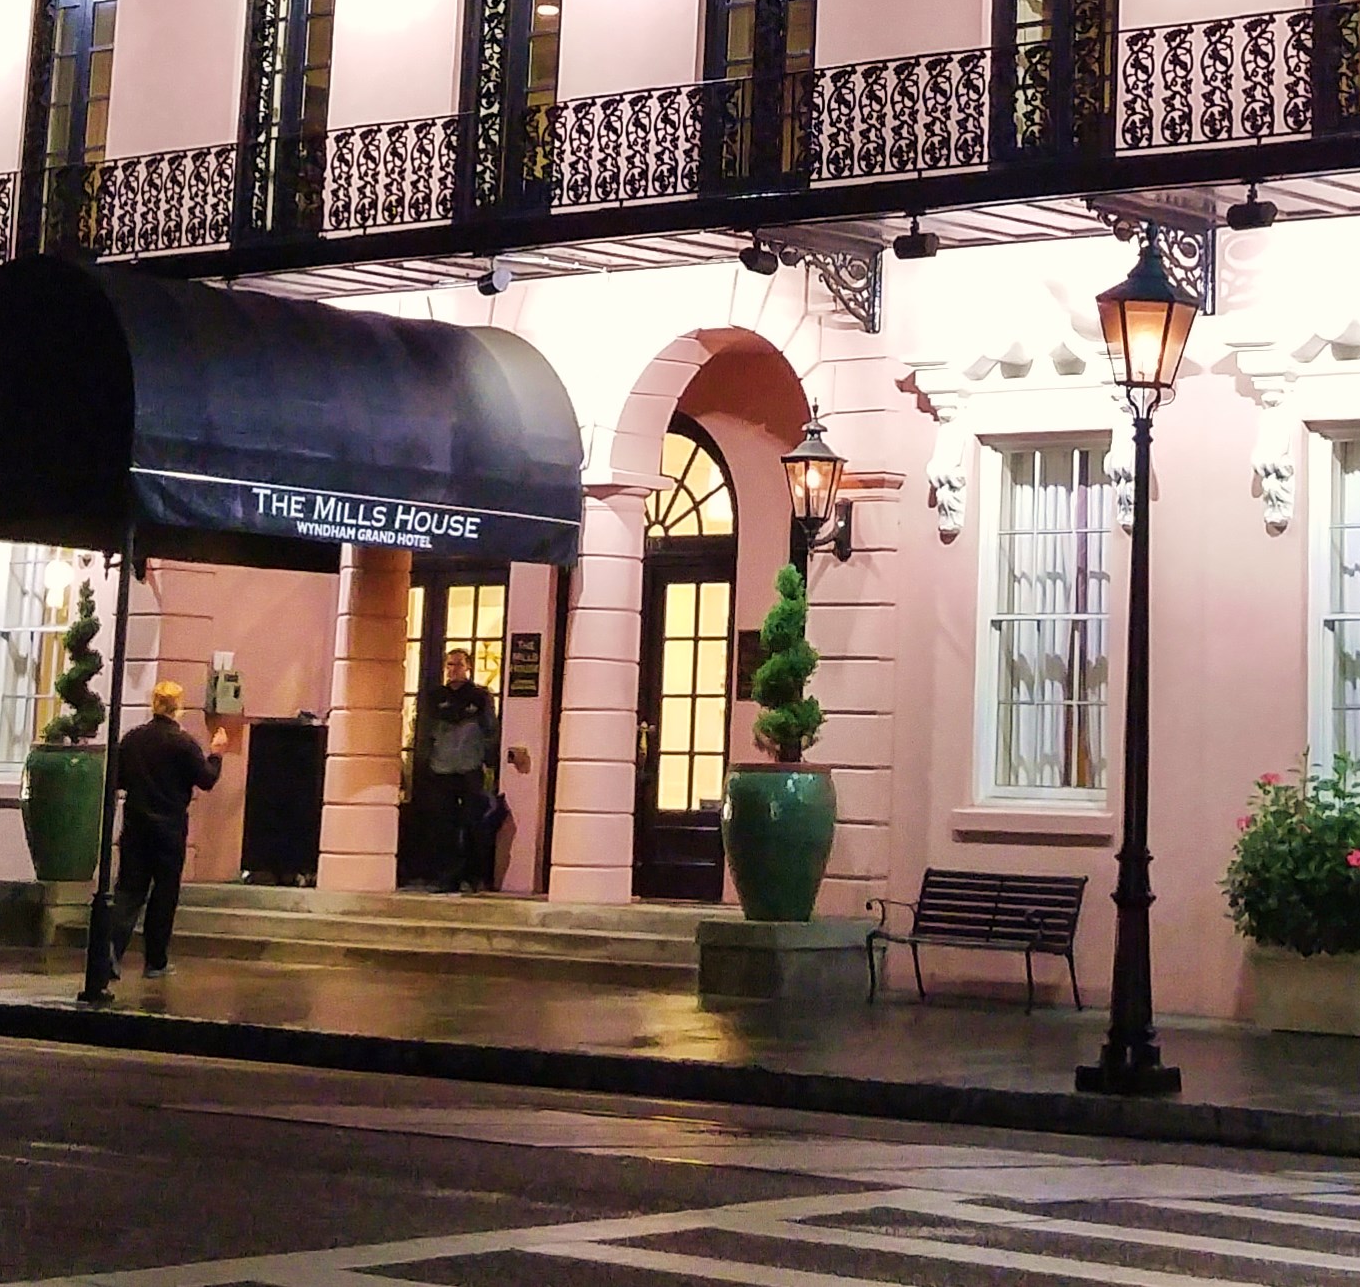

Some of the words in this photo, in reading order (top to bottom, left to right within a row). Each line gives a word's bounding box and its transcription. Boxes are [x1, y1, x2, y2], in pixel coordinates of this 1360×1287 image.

[252, 487, 306, 518] THE
[314, 495, 387, 528] MILLS
[394, 505, 481, 539] HOUSE
[297, 521, 356, 540] WYNDHAM
[357, 528, 396, 545] GRAND
[396, 533, 432, 549] HOTEL
